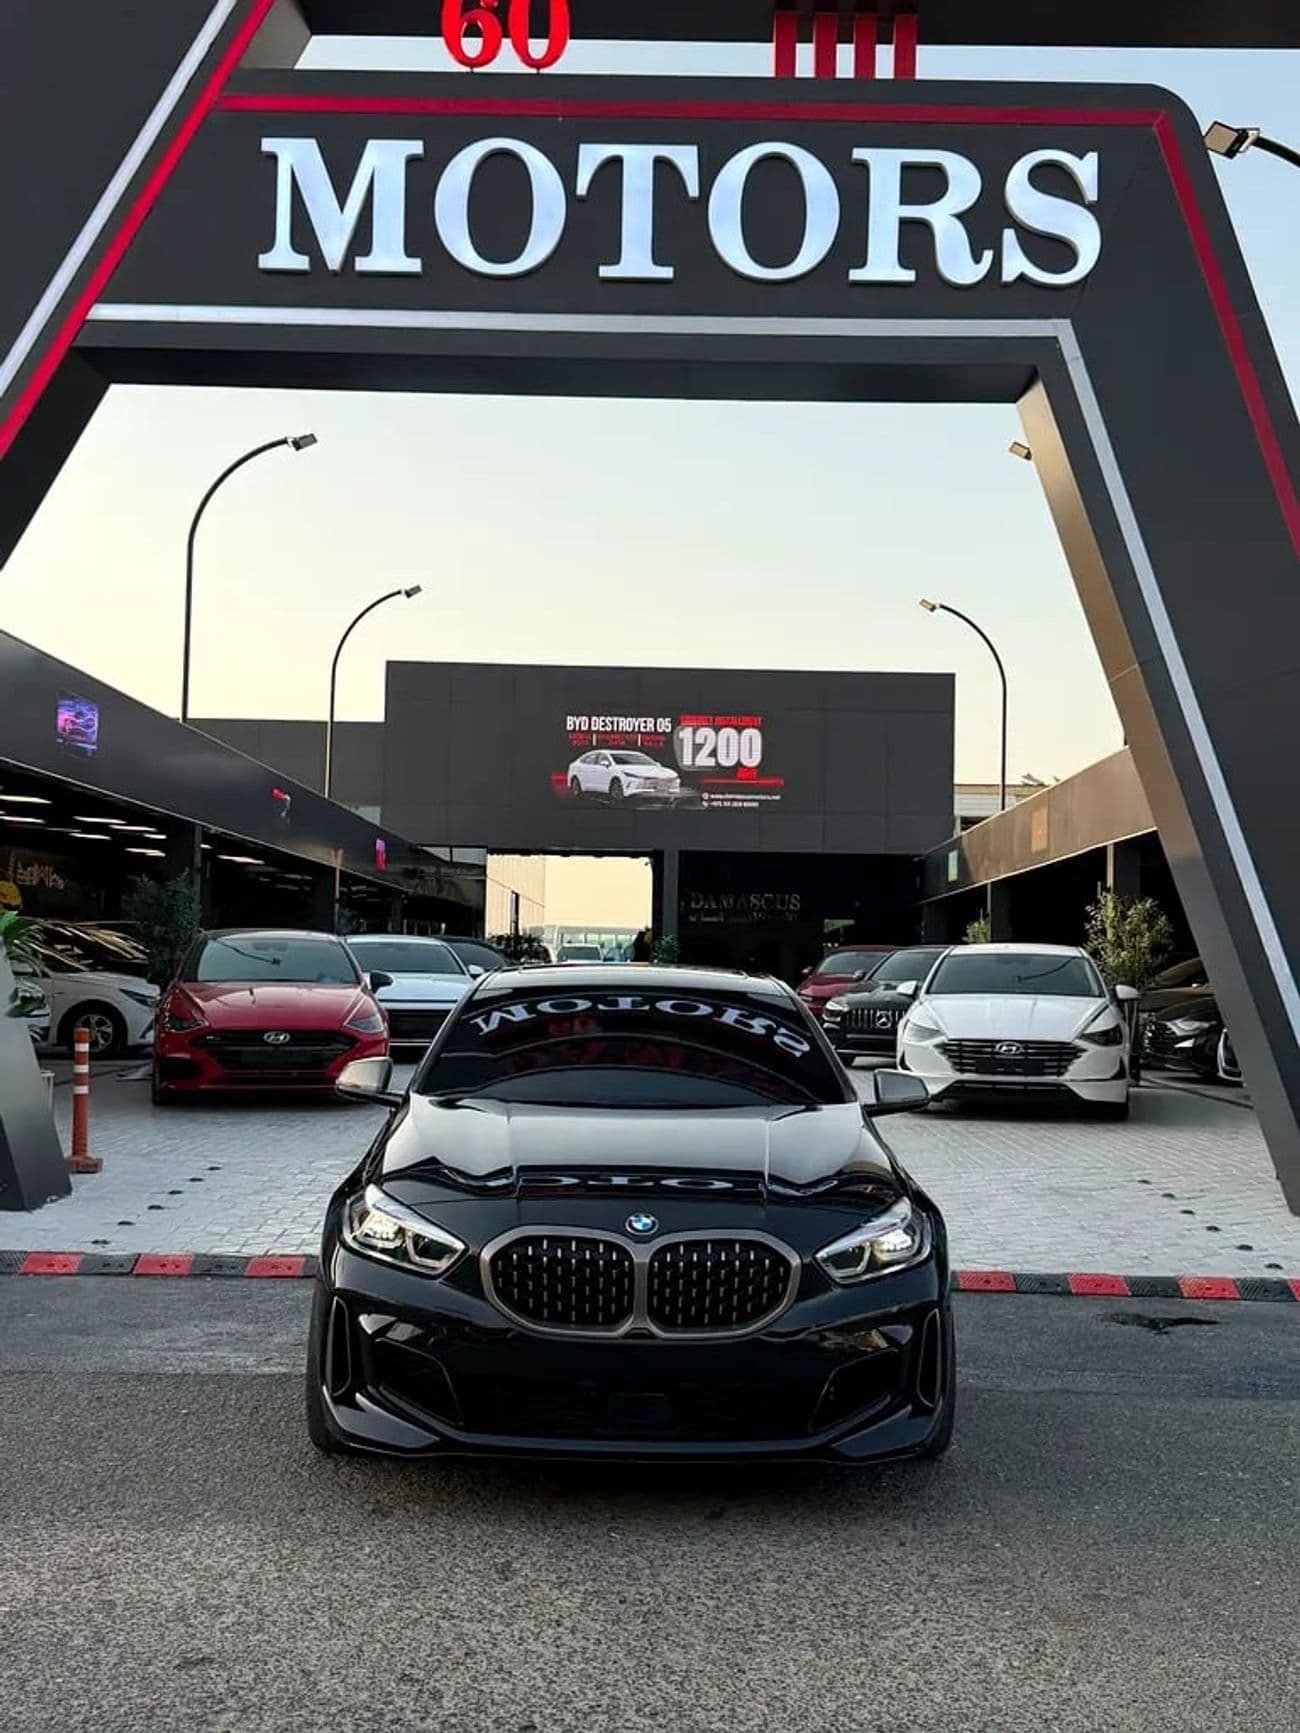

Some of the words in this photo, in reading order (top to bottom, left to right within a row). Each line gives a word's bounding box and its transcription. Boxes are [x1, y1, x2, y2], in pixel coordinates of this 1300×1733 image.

[441, 0, 570, 69] 60
[257, 136, 1102, 287] MOTORS
[566, 715, 589, 731] BYD
[591, 716, 655, 732] DESTROYER
[656, 718, 672, 733] 05
[678, 726, 763, 768] 1200
[689, 892, 801, 911] DAMASCUS
